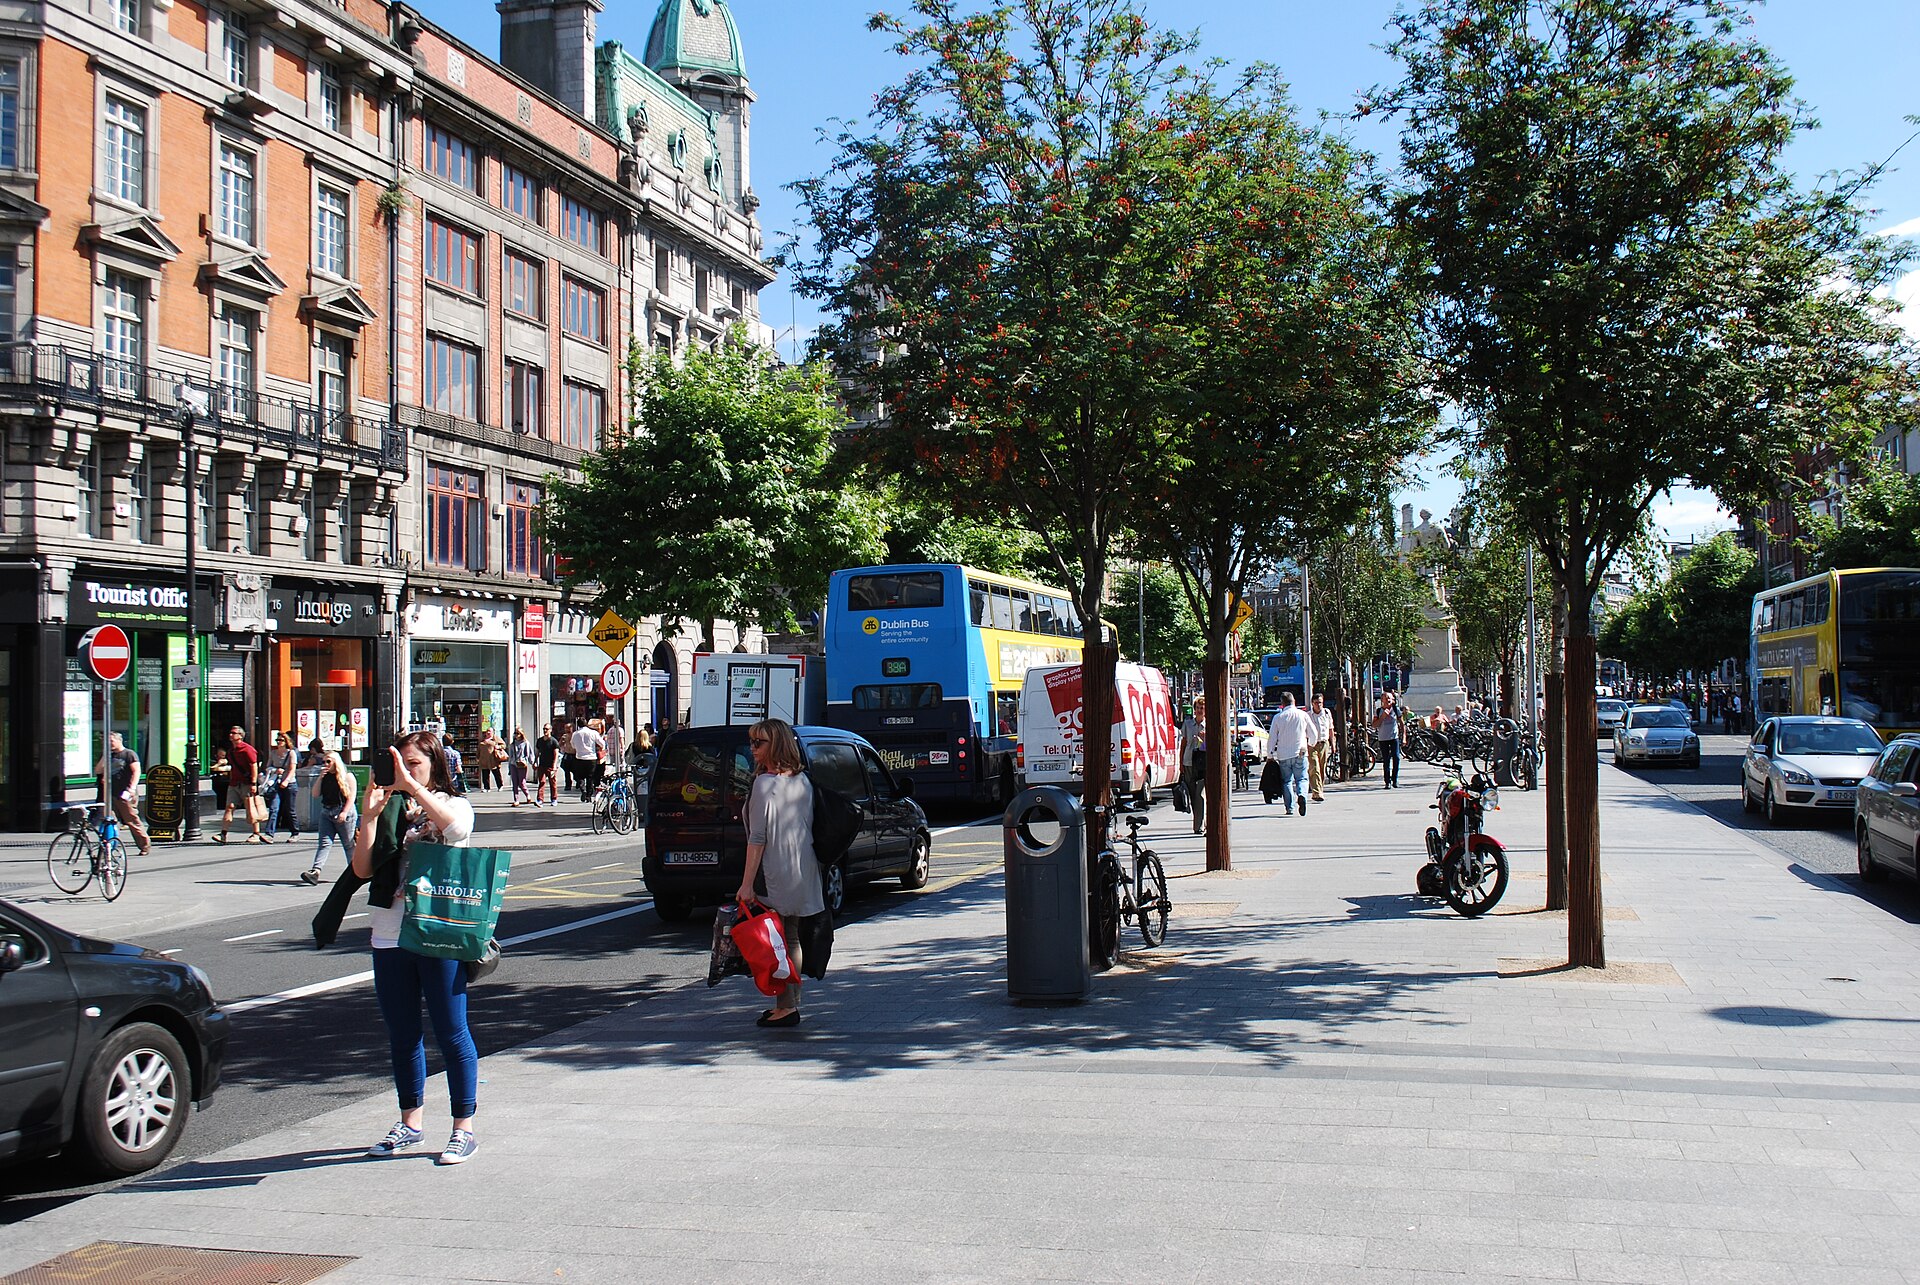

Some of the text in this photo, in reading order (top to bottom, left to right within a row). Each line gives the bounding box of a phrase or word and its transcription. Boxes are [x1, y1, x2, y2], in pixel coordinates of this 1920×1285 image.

[86, 582, 188, 608] Tourist Offic
[271, 599, 281, 610] 16
[364, 605, 374, 615] 16
[443, 607, 483, 630] Londis
[881, 619, 930, 629] Dublin Bus
[417, 649, 450, 663] SUBWAY
[523, 650, 536, 674] 14
[609, 670, 624, 685] 30
[1046, 667, 1081, 684] graphics and
[1048, 679, 1067, 688] display
[878, 748, 901, 762] Ray
[931, 752, 948, 760] 98FM
[1043, 745, 1059, 755] Tel:
[1061, 744, 1071, 754] 01
[887, 754, 916, 771] Foley
[673, 851, 713, 862] 01-D-48852
